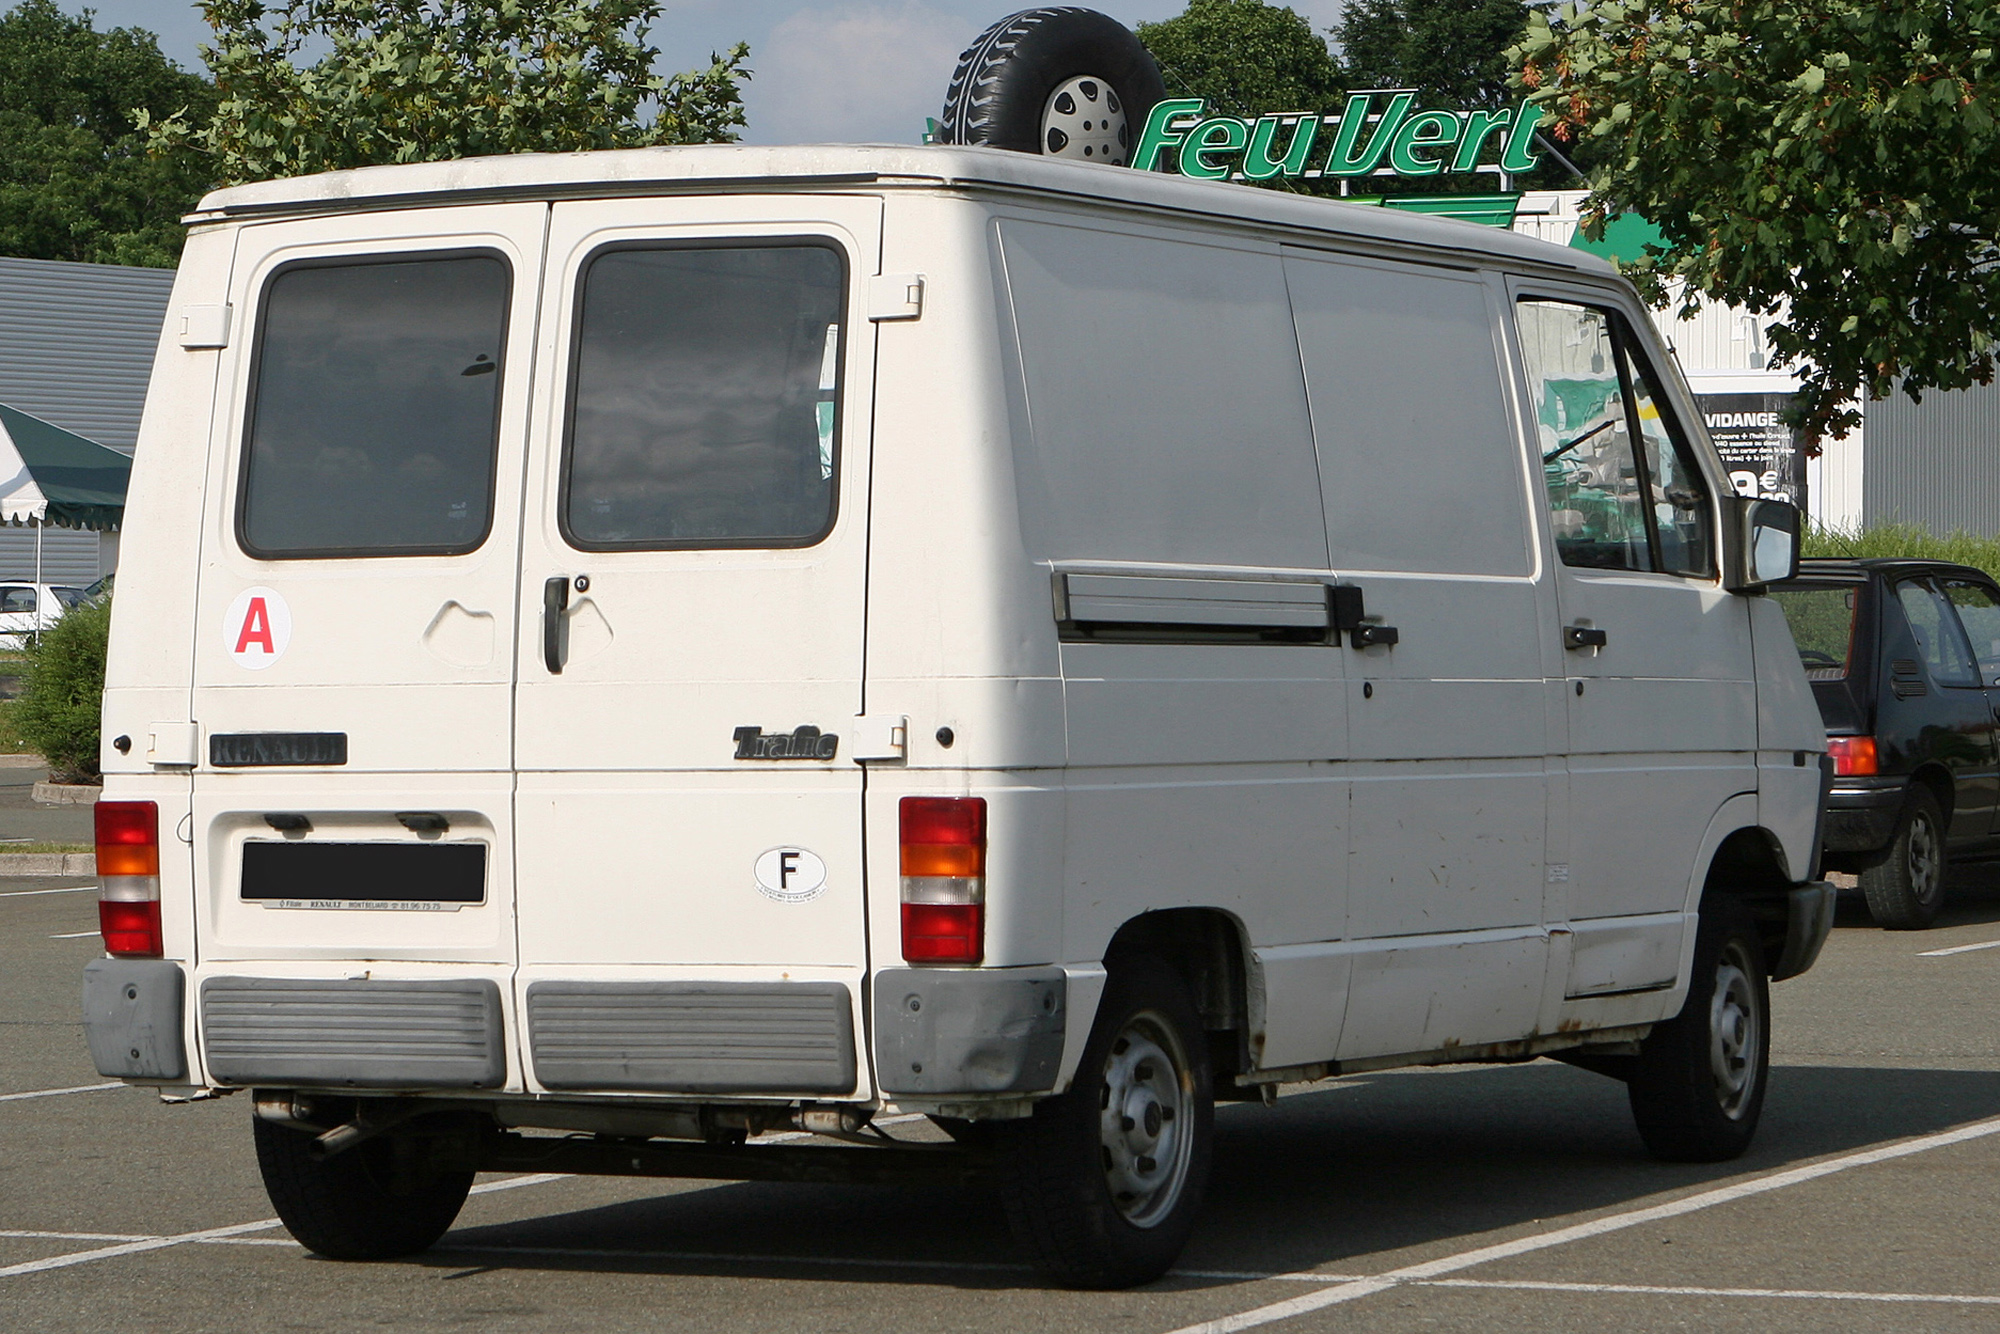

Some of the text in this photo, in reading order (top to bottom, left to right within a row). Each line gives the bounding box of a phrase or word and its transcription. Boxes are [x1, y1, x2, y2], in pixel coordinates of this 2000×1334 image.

[1131, 91, 1543, 181] Feu Vert
[1704, 412, 1779, 428] VIDANGE
[234, 596, 275, 653] A
[733, 726, 839, 760] Trafic
[780, 852, 801, 889] F
